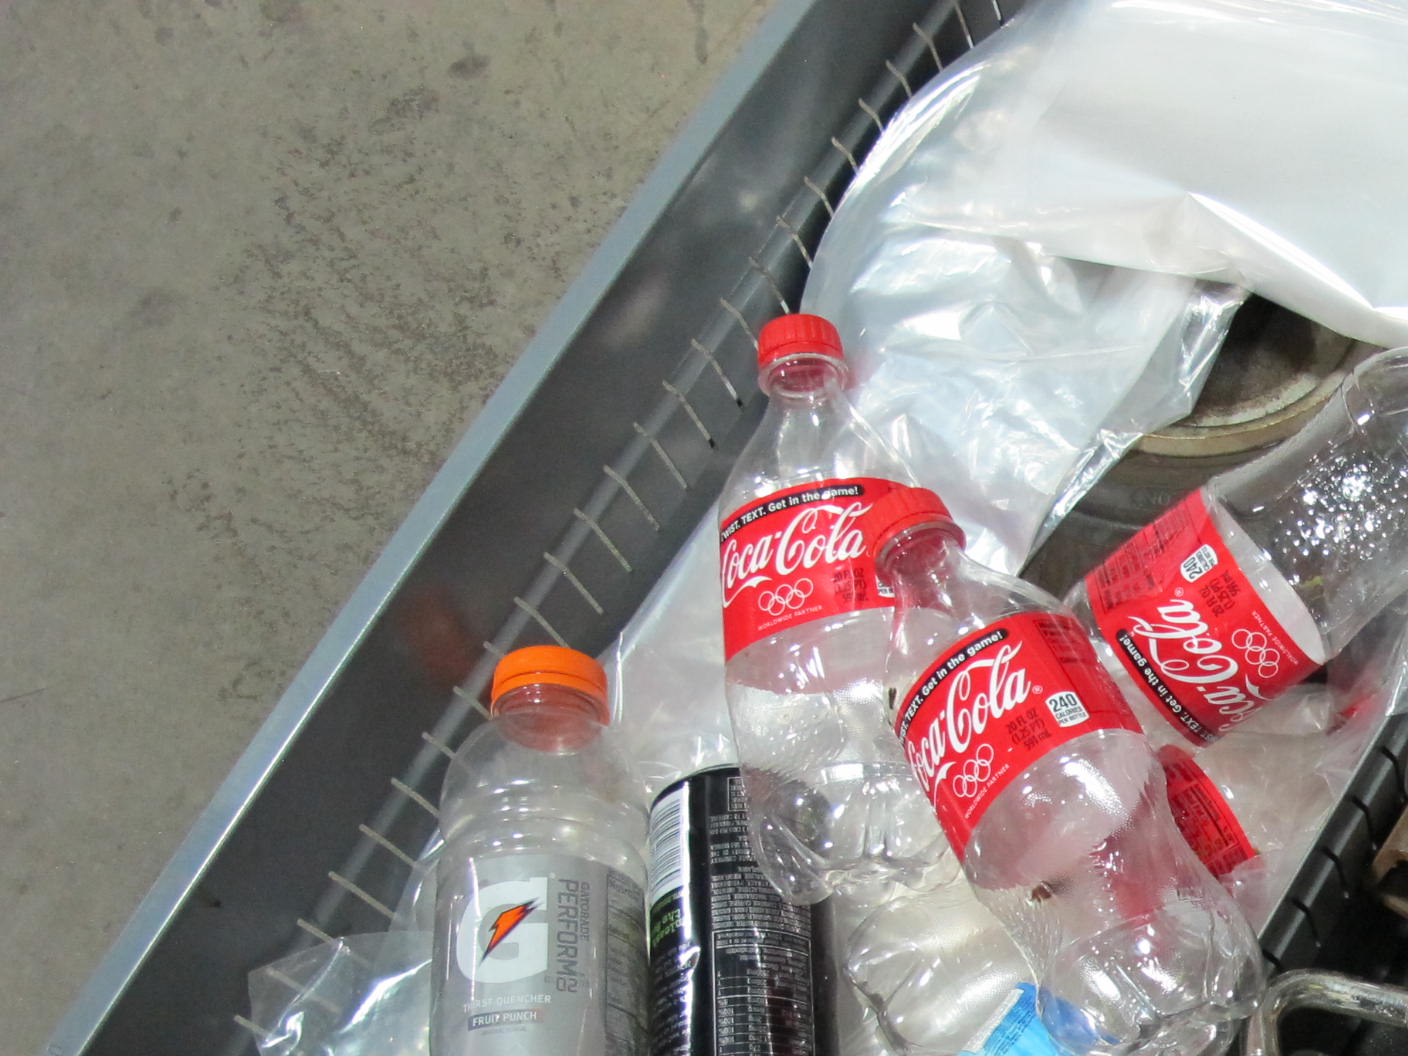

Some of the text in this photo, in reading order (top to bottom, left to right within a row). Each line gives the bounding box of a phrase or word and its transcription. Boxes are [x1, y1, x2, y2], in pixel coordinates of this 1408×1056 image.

[741, 507, 766, 525] TEXT.
[768, 497, 786, 513] Get
[789, 495, 800, 506] in
[801, 491, 820, 502] the
[722, 502, 873, 608] Coca-Cola
[1183, 557, 1203, 580] 240
[794, 605, 822, 617] PARTNER
[1118, 635, 1147, 671] game!
[905, 629, 1003, 728] TEXT. Get in the game!
[1142, 667, 1158, 688] the
[1156, 683, 1168, 698] in
[1048, 693, 1078, 713] 240
[1056, 706, 1083, 720] CALORIES
[1166, 695, 1182, 713] Get
[907, 640, 1031, 809] Coca-Cola
[987, 763, 1011, 789] PARTNER
[579, 881, 591, 942] GATORADE
[456, 876, 549, 984] G
[556, 879, 579, 977] PERFORM
[496, 993, 552, 1007] QUENCHER
[502, 1010, 538, 1023] PUNCH
